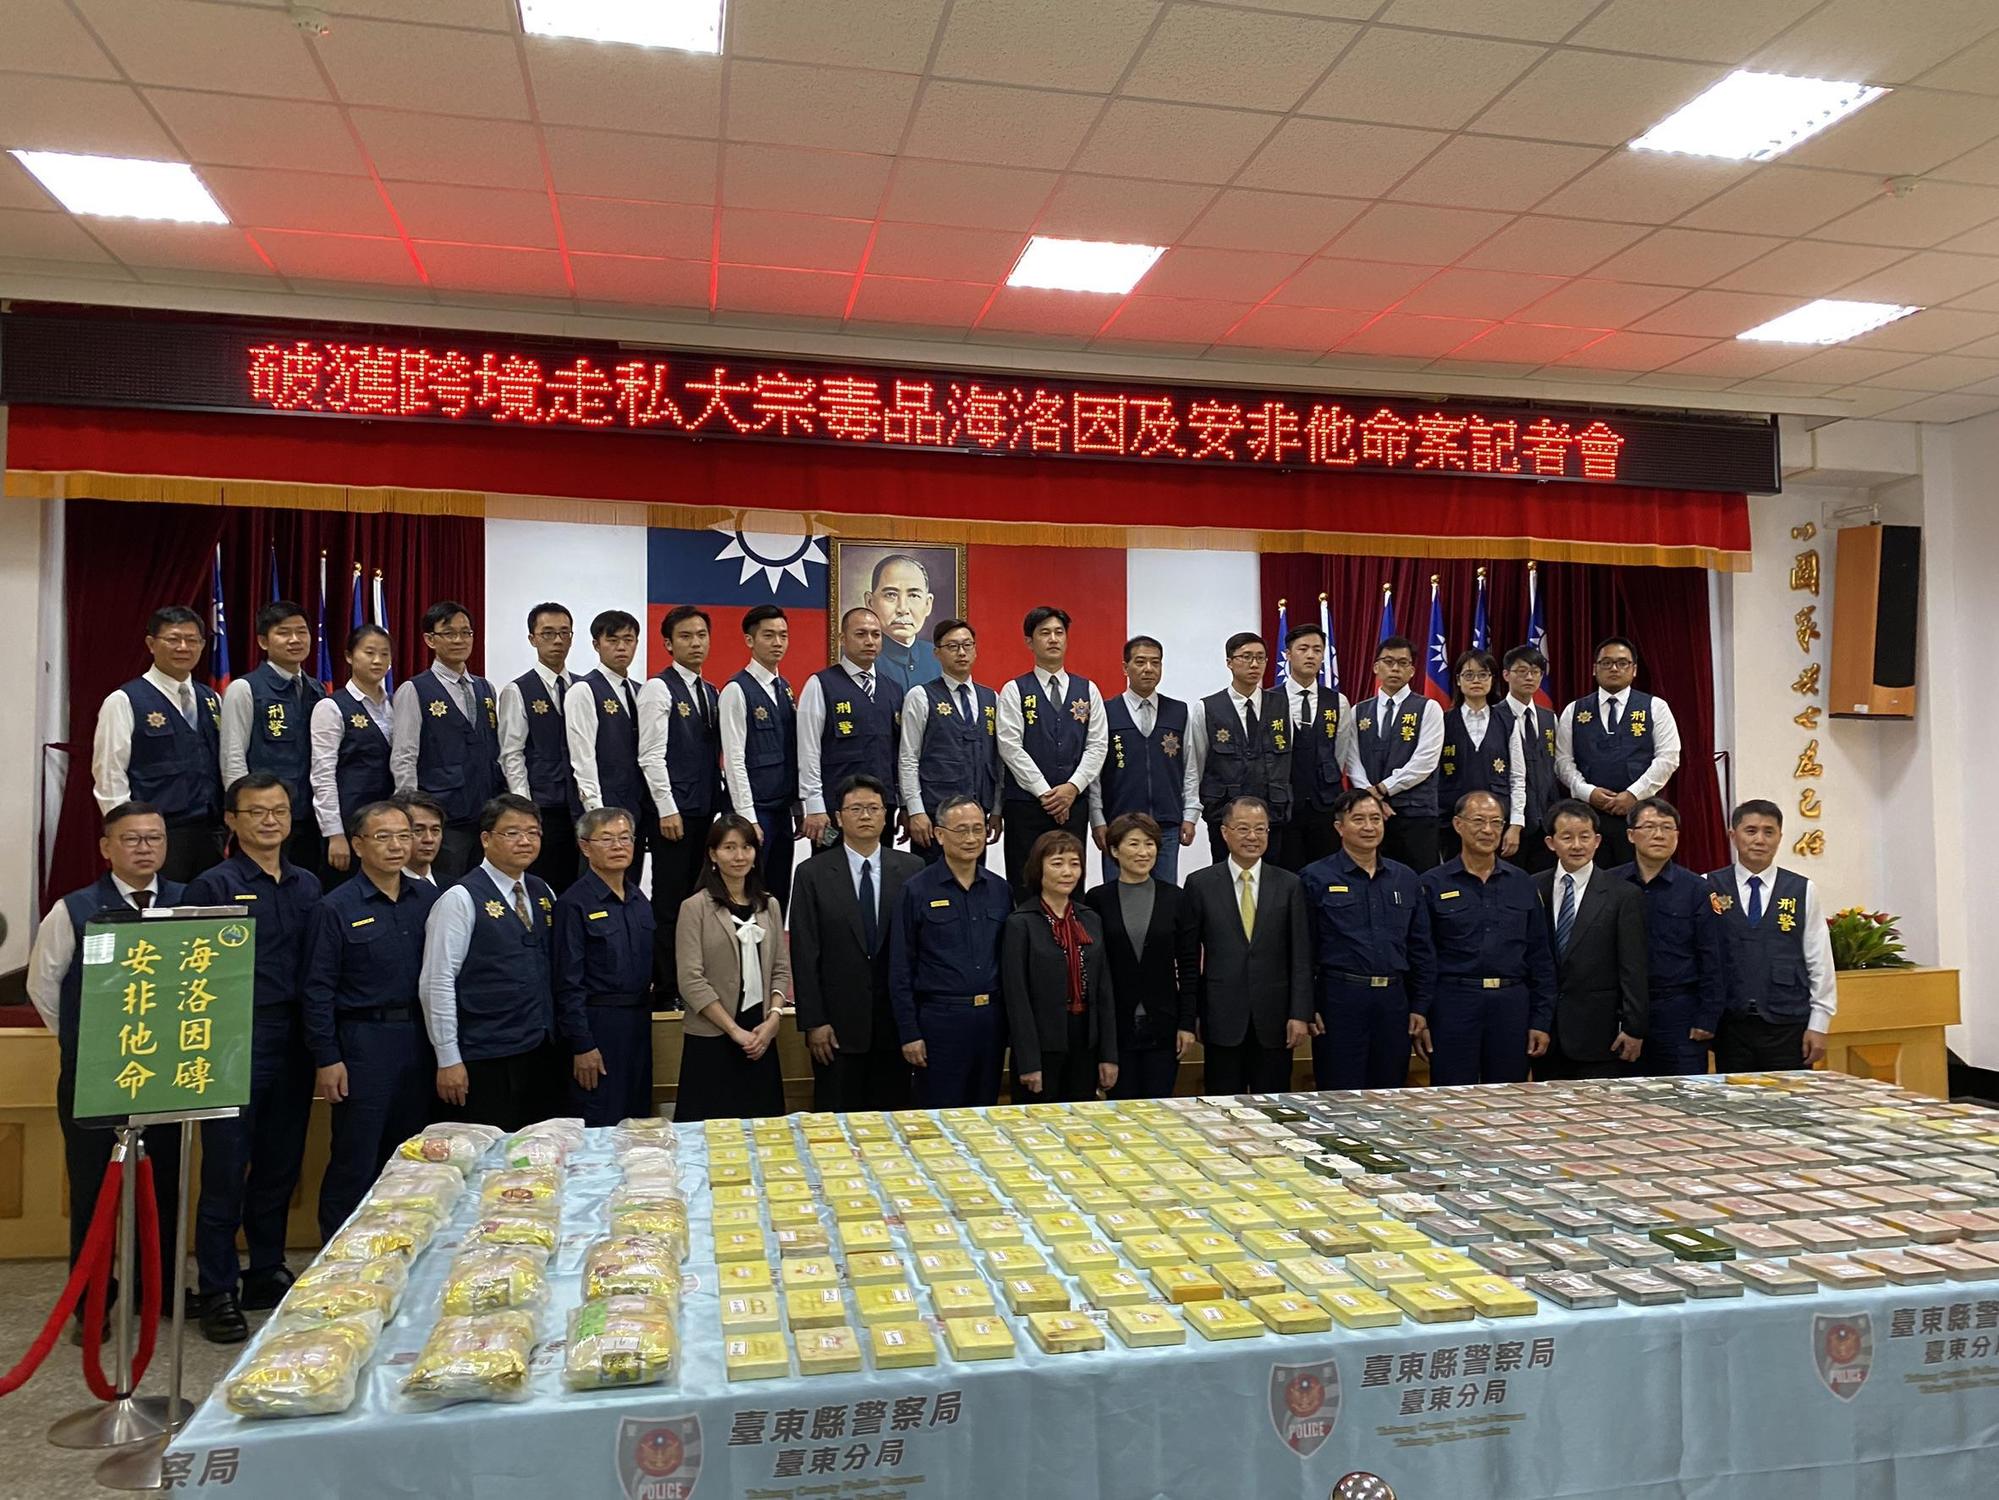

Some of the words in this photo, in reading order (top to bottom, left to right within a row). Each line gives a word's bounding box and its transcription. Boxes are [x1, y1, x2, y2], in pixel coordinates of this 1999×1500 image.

[247, 343, 1625, 480] 破獲跨境走私大宗毒品海洛因及安非他命案記者會
[268, 704, 288, 736] 刑警
[835, 701, 853, 735] 刑警
[1024, 694, 1038, 725] 刑警
[1323, 709, 1337, 739] 刑警
[1630, 710, 1646, 737] 刑警
[1271, 719, 1287, 750] 刑警
[1401, 713, 1417, 742] 刑警
[1777, 897, 1797, 932] 刑警
[113, 939, 163, 1100] 安非他命
[173, 937, 220, 1095] 海洛因磚
[1360, 1337, 1555, 1388] 臺東縣警察局
[1923, 1335, 1999, 1365] 臺東分
[1398, 1379, 1507, 1416] 臺東分局
[727, 1390, 963, 1447] 臺東縣警察局
[1288, 1421, 1326, 1439] POLICE
[773, 1439, 905, 1478] 臺東分局
[639, 1482, 684, 1500] POLICE
